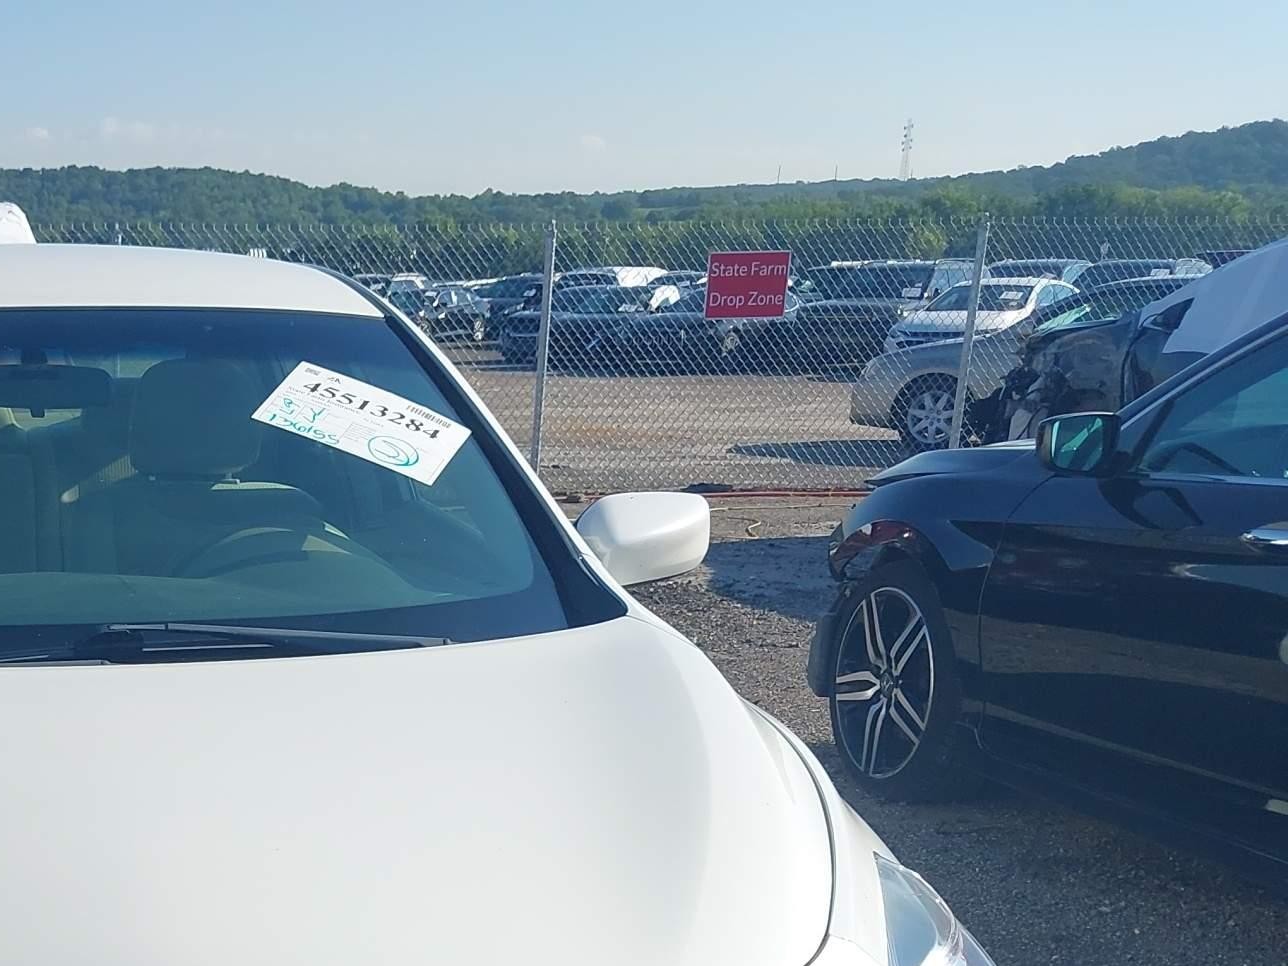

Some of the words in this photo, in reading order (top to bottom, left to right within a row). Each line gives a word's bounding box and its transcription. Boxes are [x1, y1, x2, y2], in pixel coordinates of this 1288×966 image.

[710, 262, 748, 277] State
[752, 261, 787, 276] Farm
[709, 292, 745, 309] Drop
[747, 291, 784, 306] Zone
[303, 382, 441, 439] 45513284
